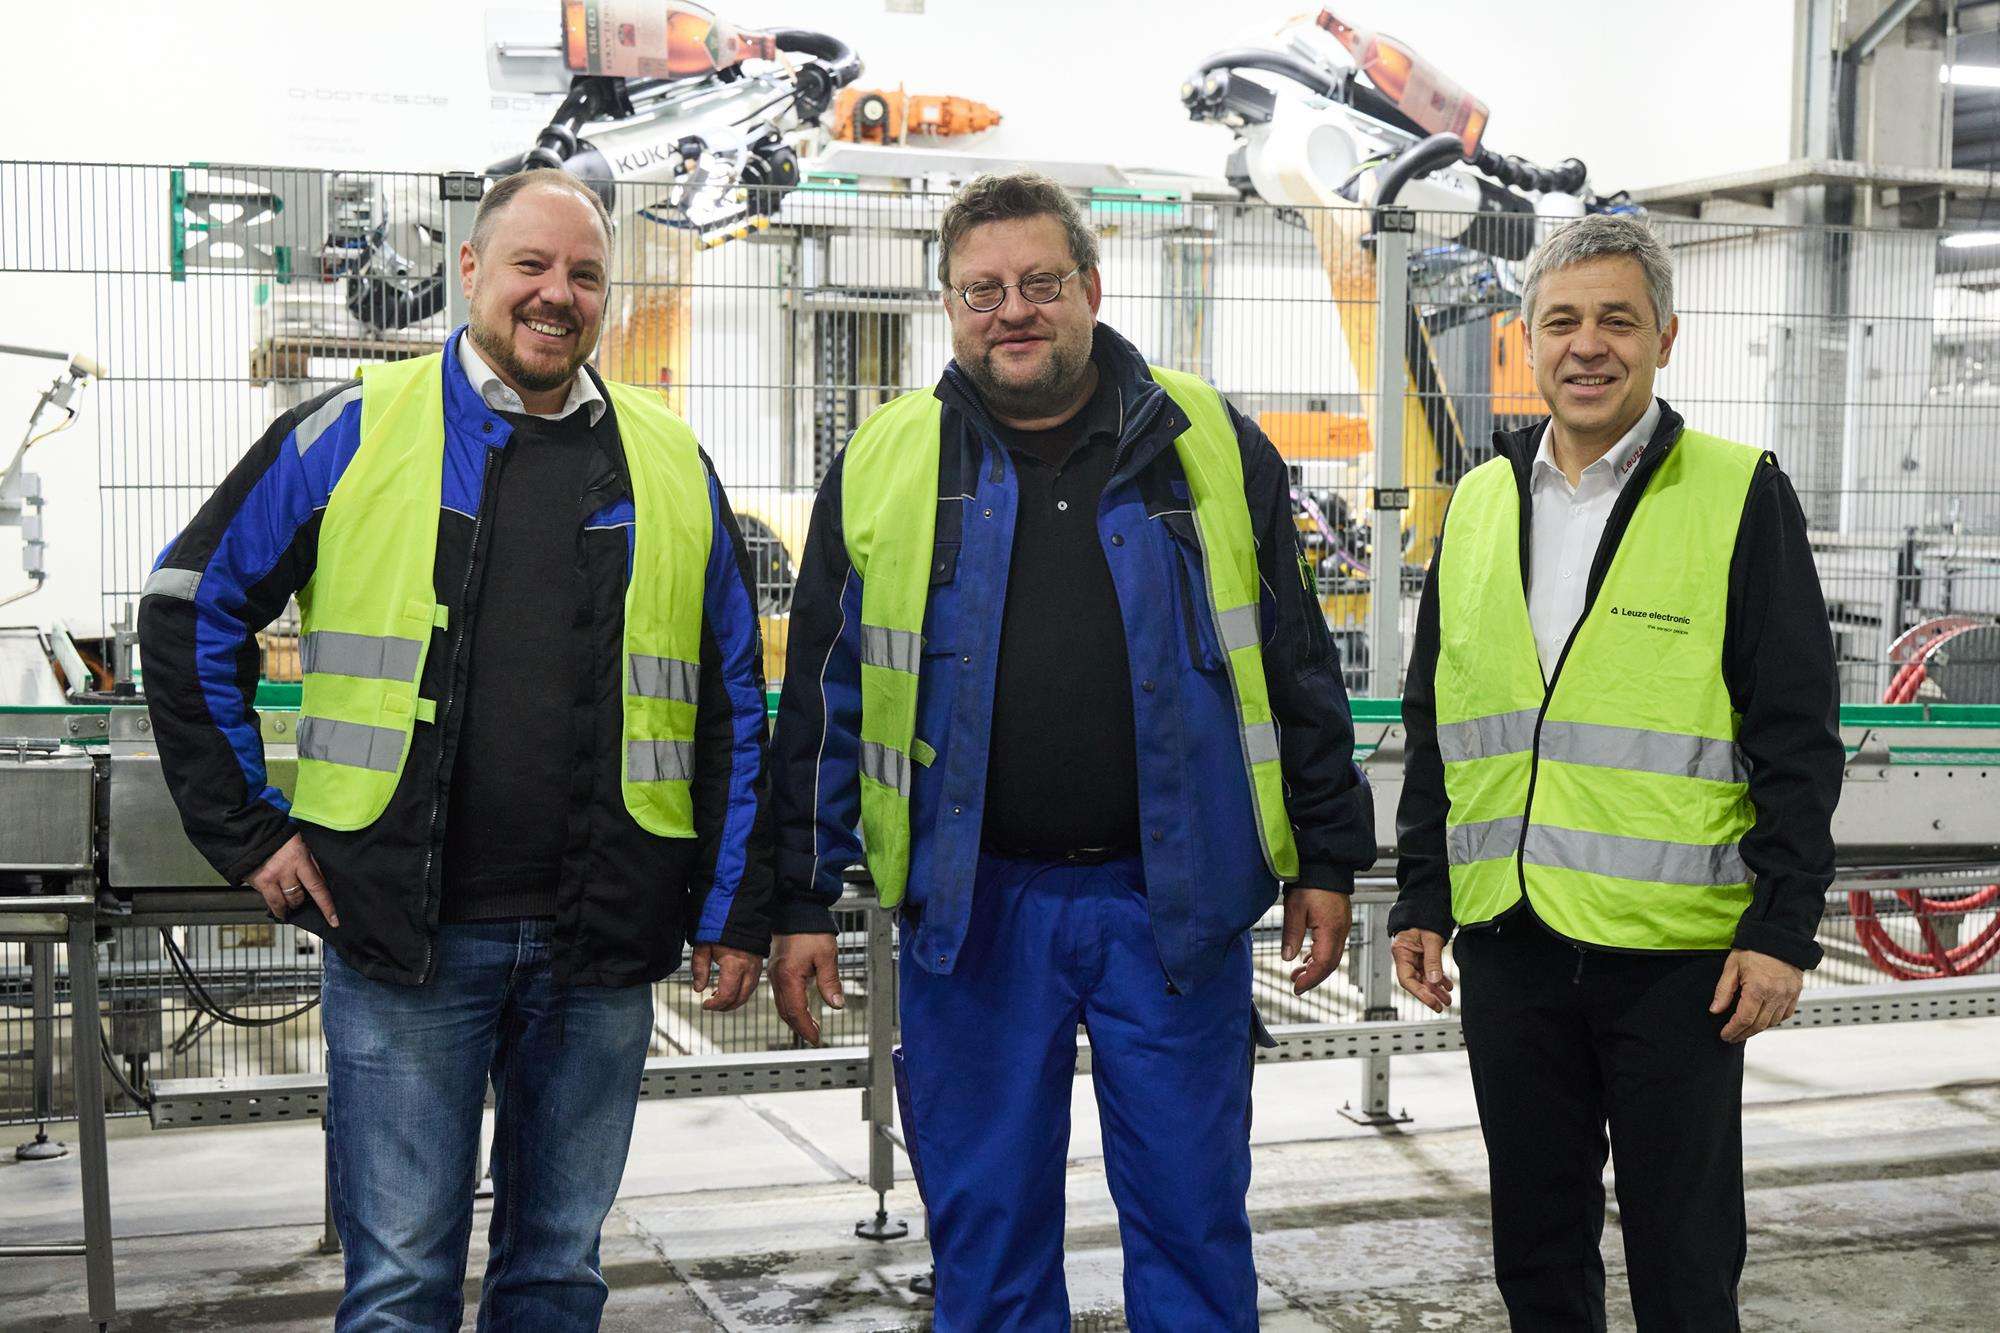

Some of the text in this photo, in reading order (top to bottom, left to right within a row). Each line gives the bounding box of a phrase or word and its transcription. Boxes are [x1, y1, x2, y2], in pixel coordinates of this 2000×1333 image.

[616, 142, 680, 174] KUKA
[1620, 445, 1645, 474] Leuze
[1621, 608, 1691, 625] Leuze electronic
